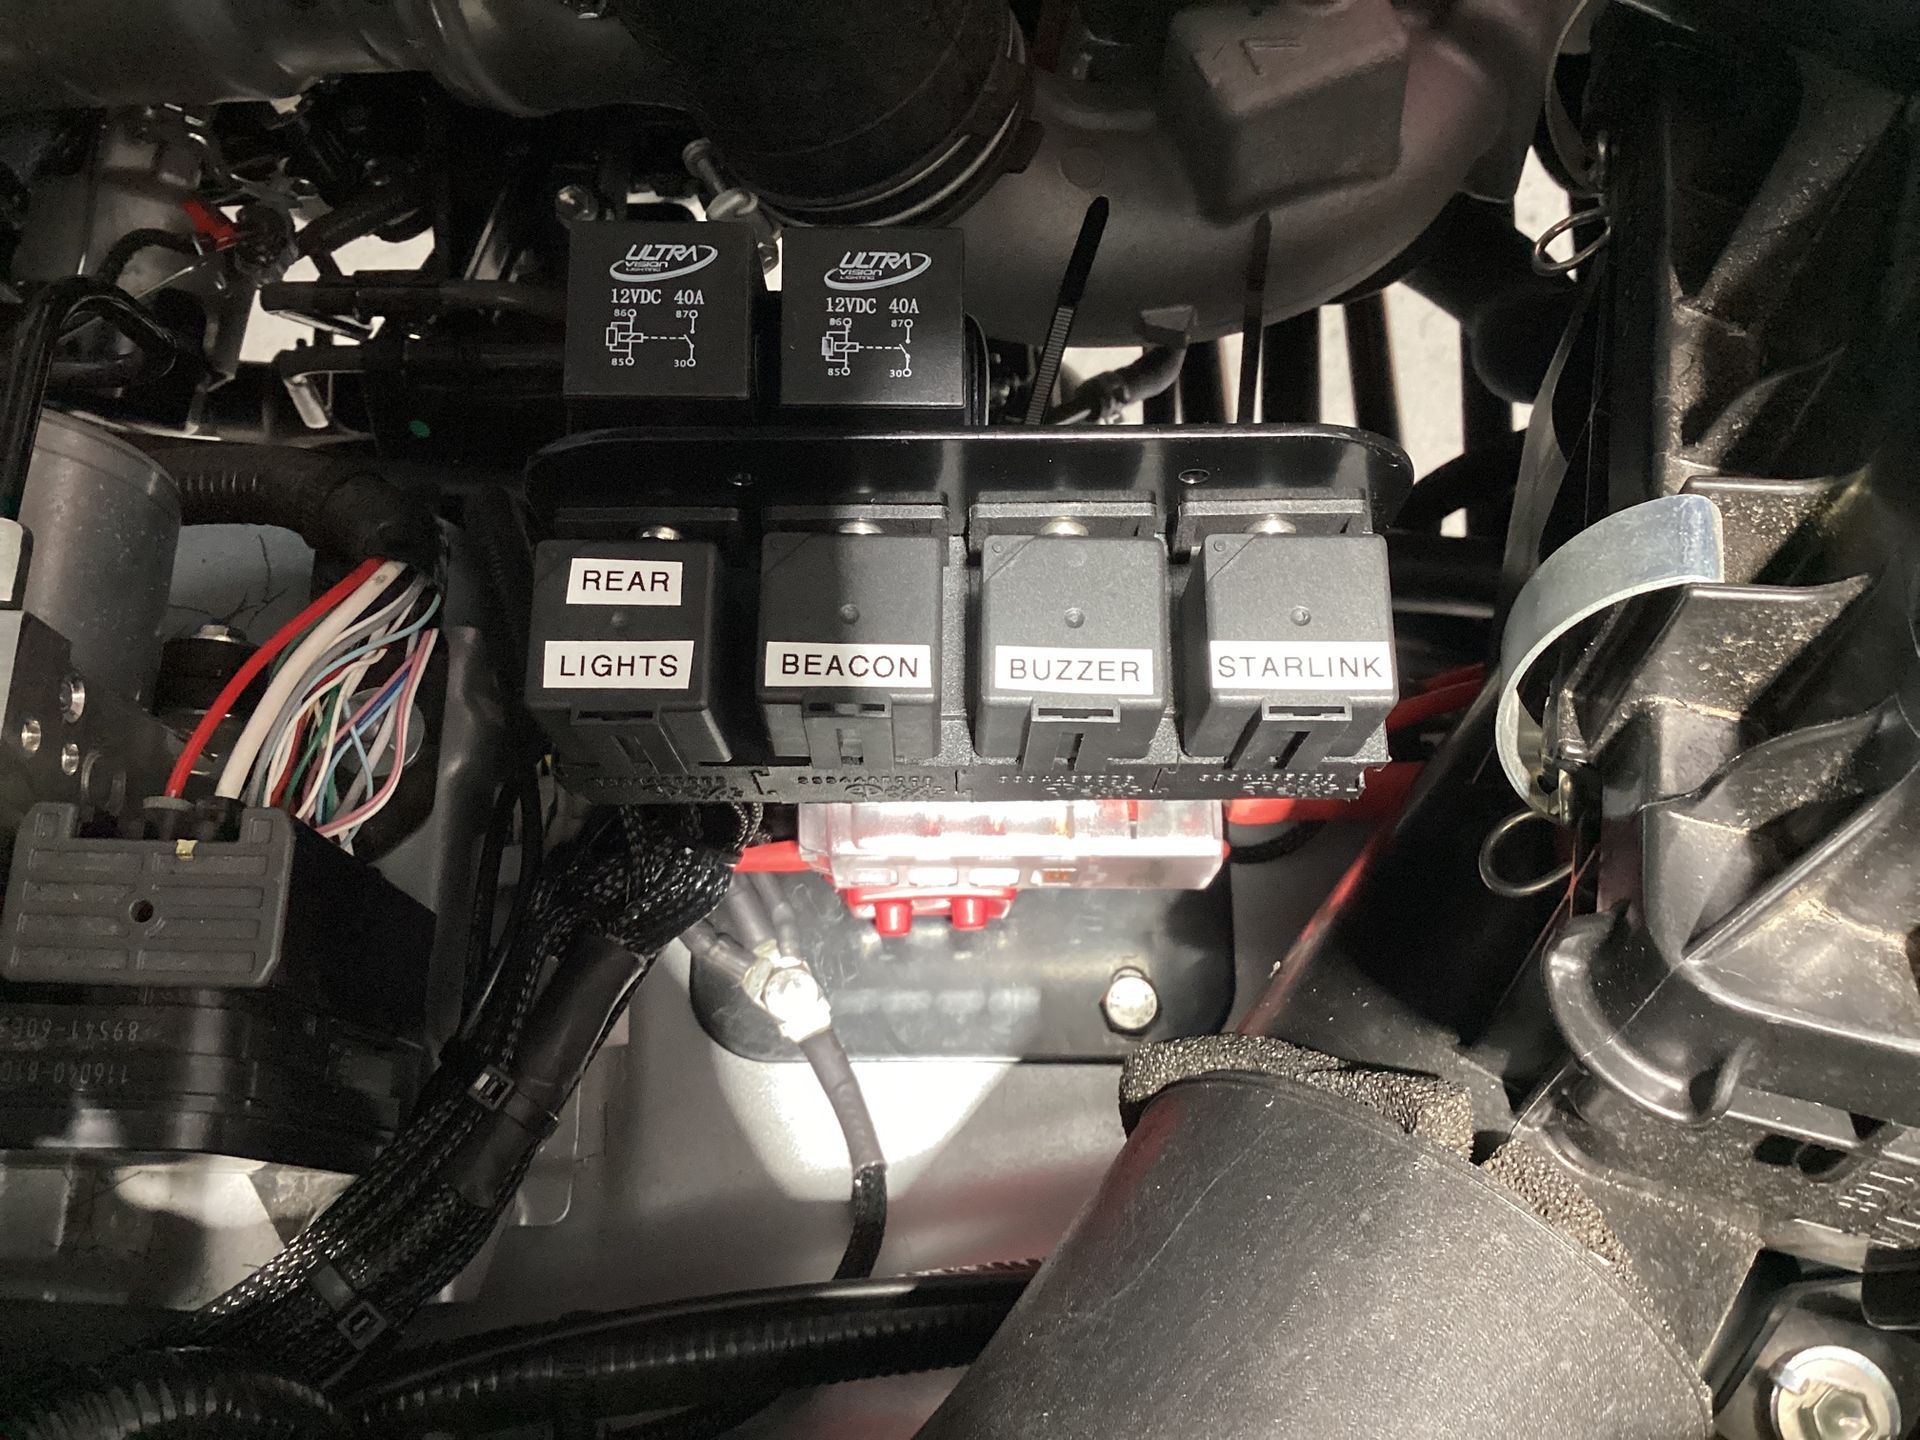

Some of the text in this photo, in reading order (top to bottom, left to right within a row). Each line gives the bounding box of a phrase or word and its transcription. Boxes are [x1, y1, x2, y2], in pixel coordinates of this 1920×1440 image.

[625, 244, 697, 261] ULTRA
[839, 251, 912, 269] ULTRA
[610, 288, 705, 305] 12VDC 40A
[613, 309, 626, 317] 86
[675, 310, 688, 318] 87
[825, 297, 920, 314] 12VDC 40A
[828, 318, 842, 326] 86
[890, 319, 903, 328] 87
[611, 358, 624, 366] 85
[673, 359, 686, 367] 30
[827, 368, 840, 376] 85
[889, 369, 902, 377] 30
[582, 569, 670, 592] REAR
[560, 654, 678, 677] LIGHTS
[782, 653, 918, 678] BEACON
[1009, 658, 1140, 682] BUZZER
[1217, 655, 1383, 679] STARLINK
